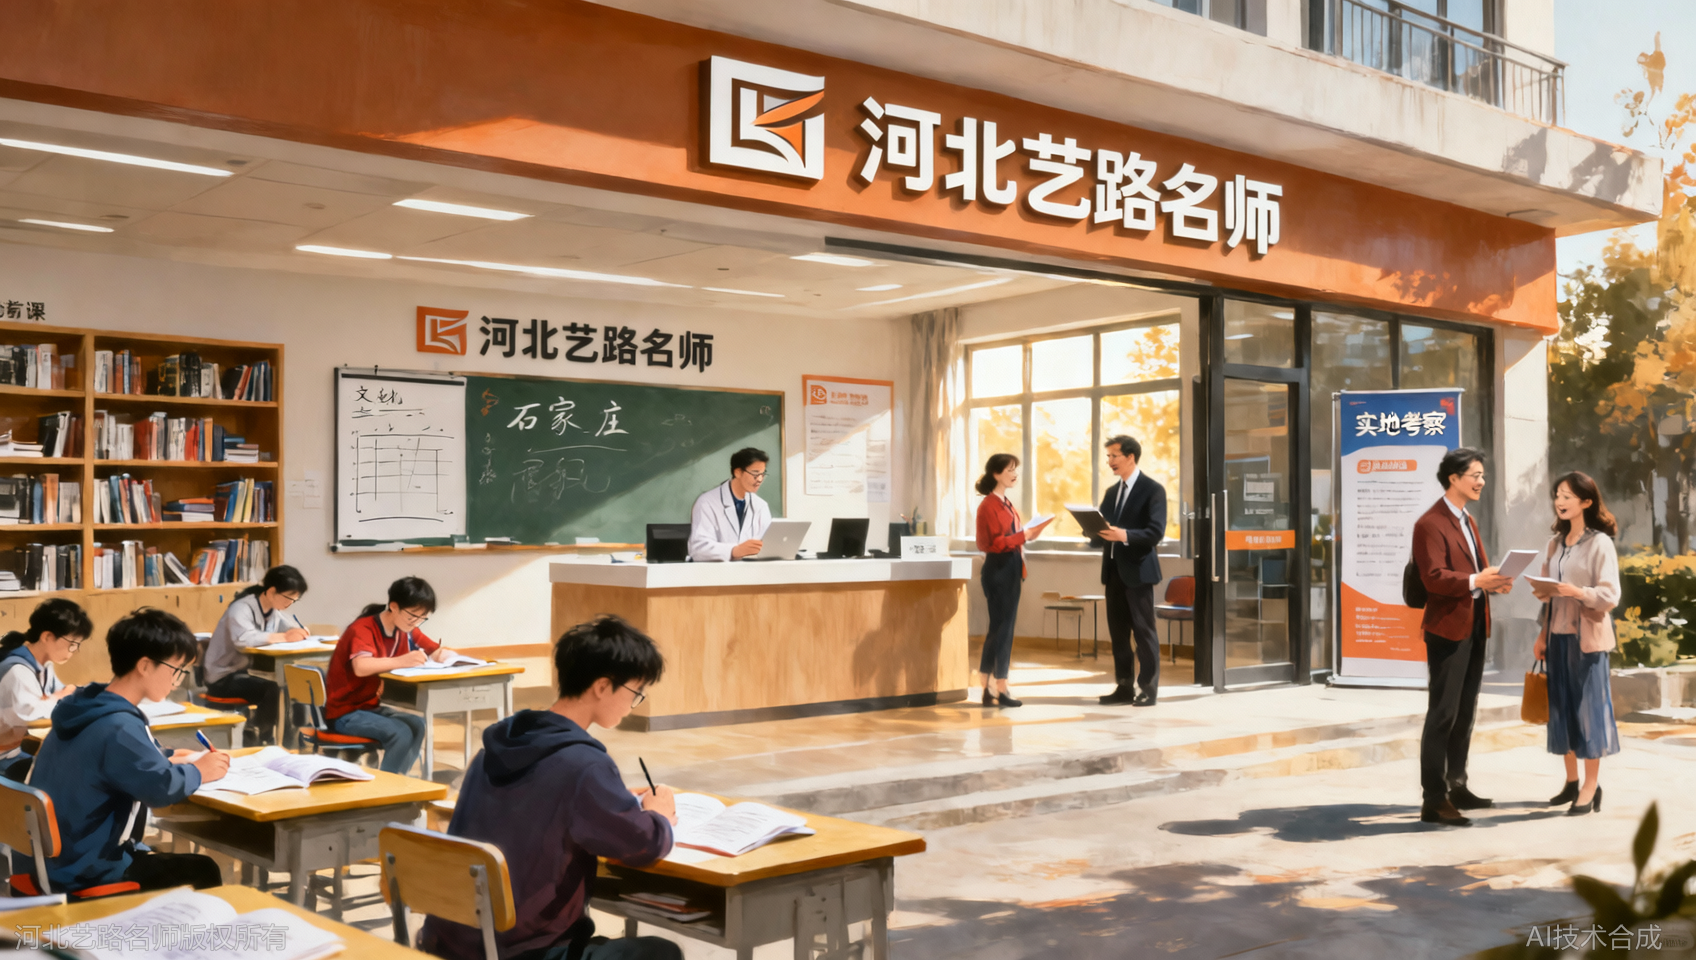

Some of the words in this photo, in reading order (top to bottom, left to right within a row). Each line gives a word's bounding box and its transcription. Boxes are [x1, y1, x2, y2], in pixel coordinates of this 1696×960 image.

[859, 96, 1283, 256] 河北艺路名师
[479, 315, 715, 373] 河北艺路名师
[507, 396, 629, 437] 石家庄
[1355, 411, 1447, 437] 实地考察
